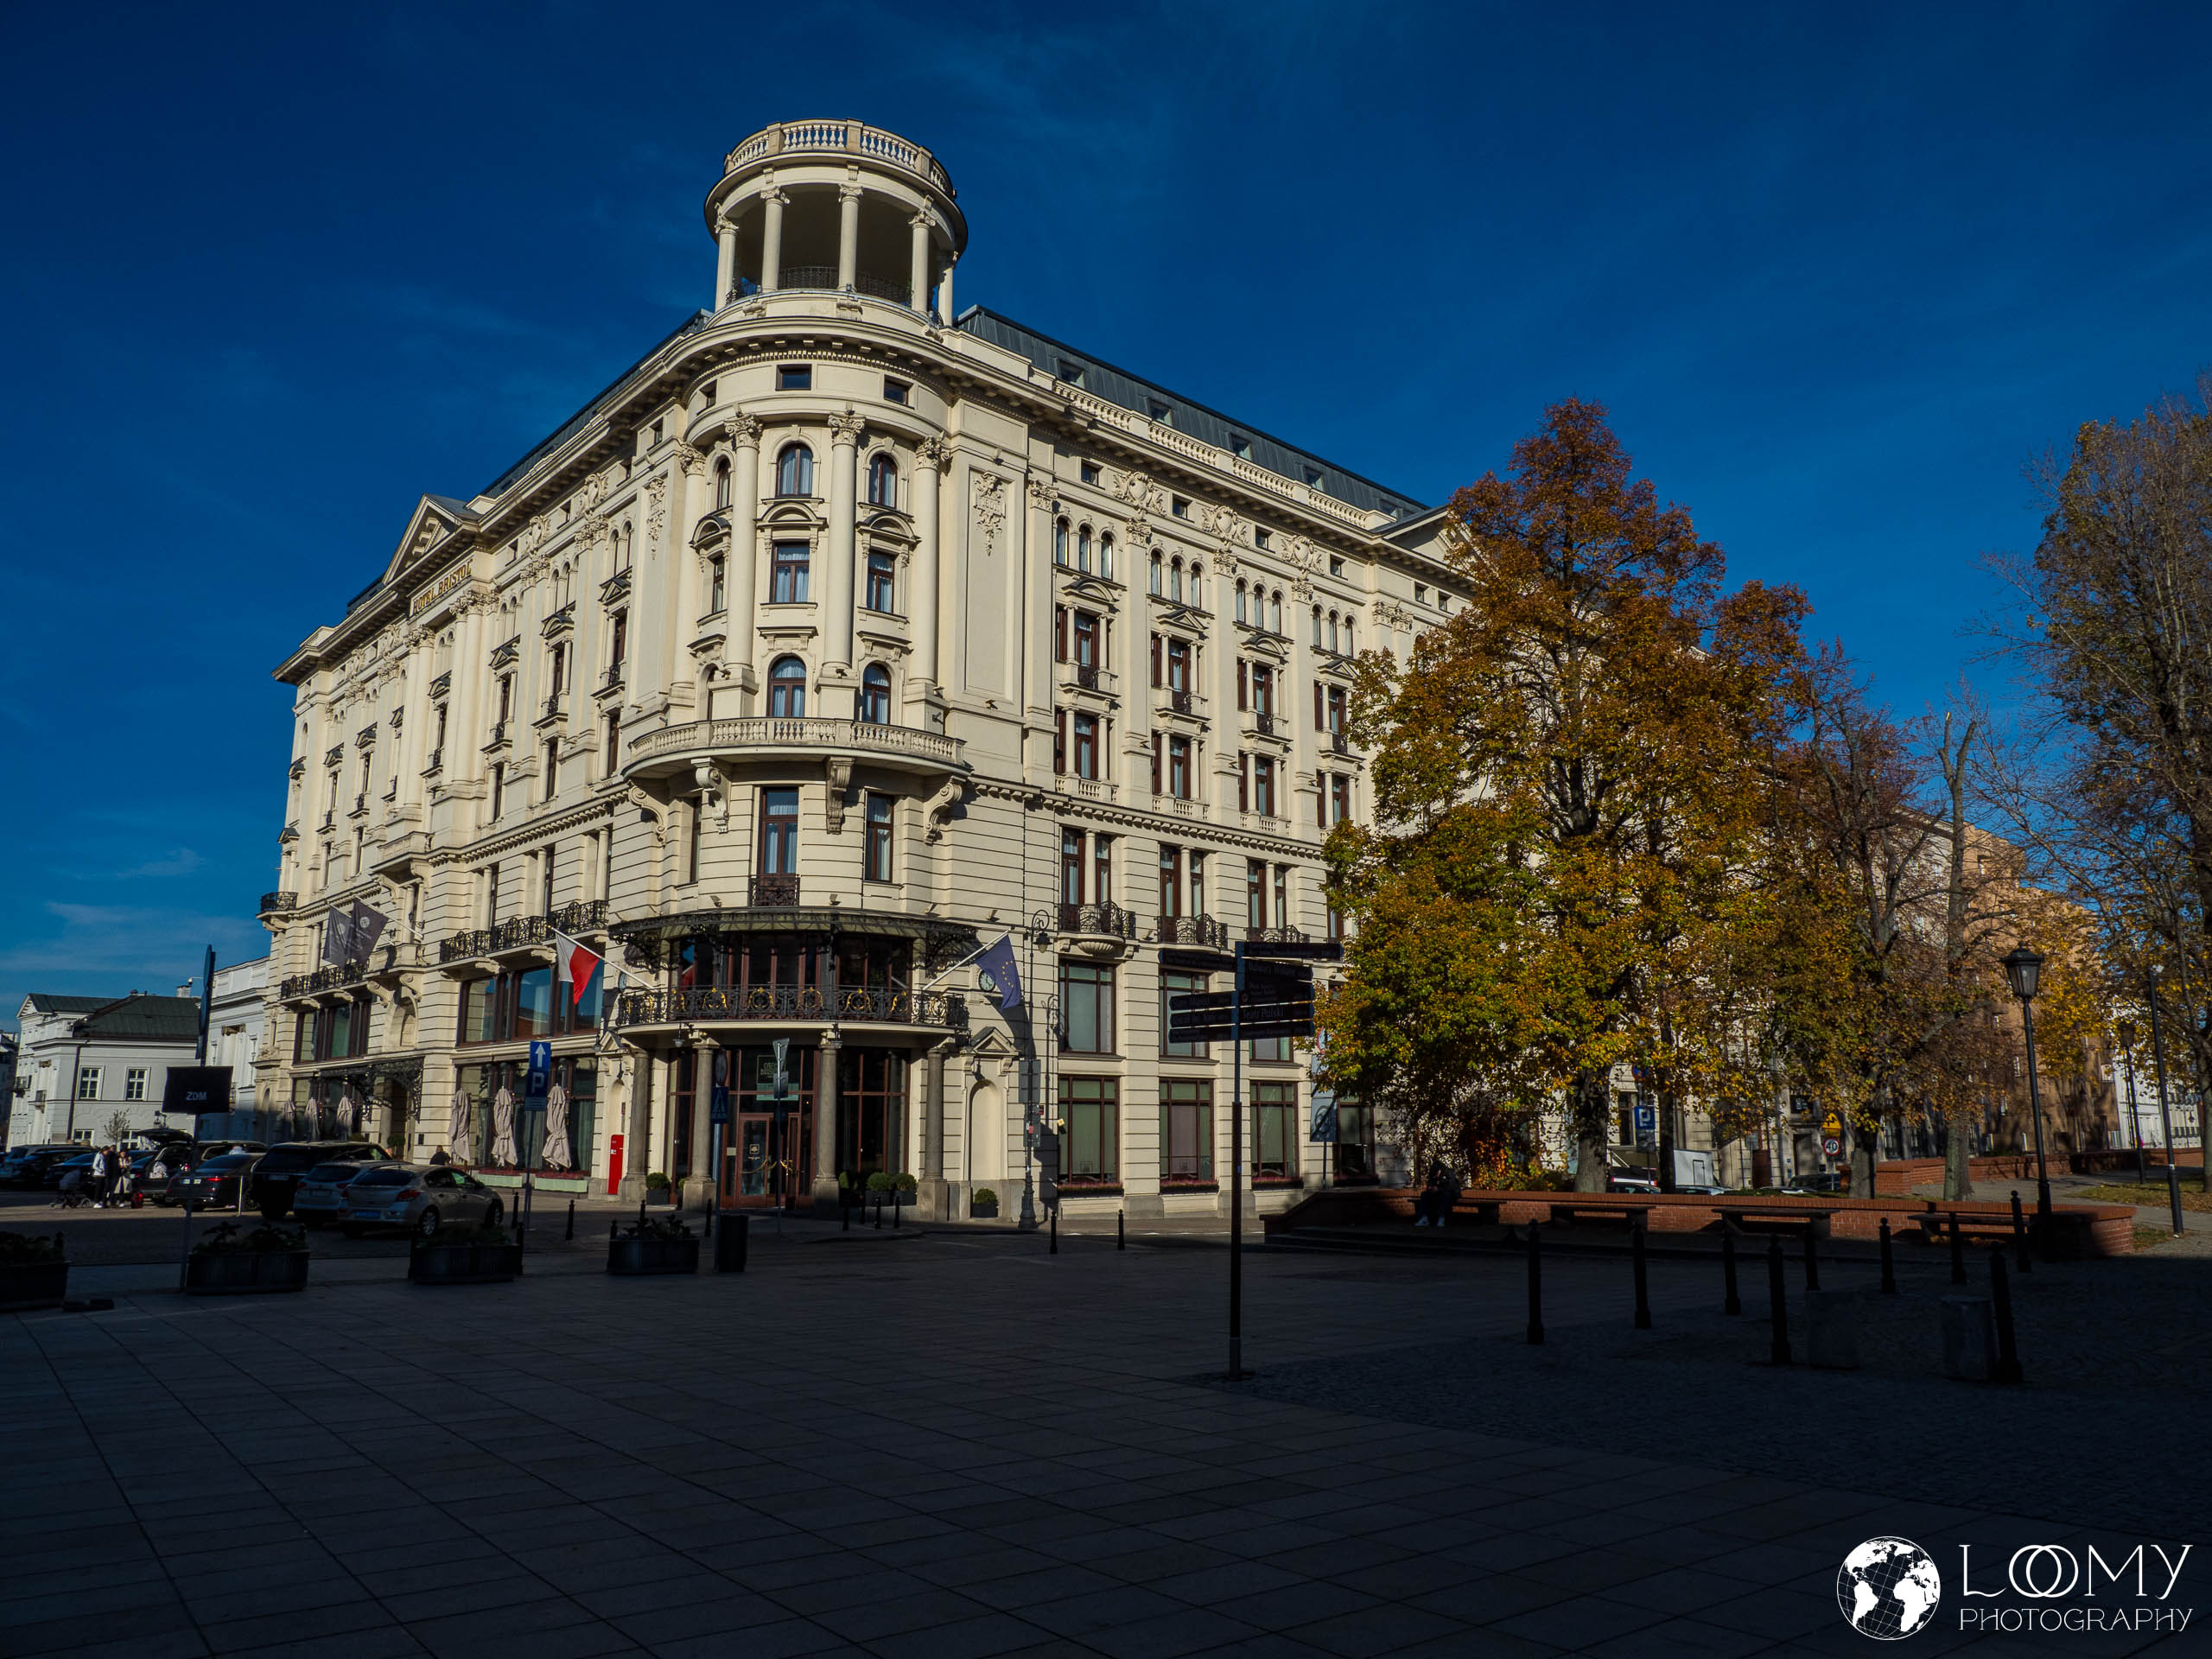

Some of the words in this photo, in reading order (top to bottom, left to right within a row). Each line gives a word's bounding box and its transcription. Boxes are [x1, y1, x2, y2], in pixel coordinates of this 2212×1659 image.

[413, 588, 436, 613] HOTEL
[438, 558, 473, 595] BRISTOL
[531, 1071, 545, 1093] P
[186, 1091, 208, 1102] ZDM
[1637, 1108, 1651, 1127] P
[1826, 1141, 1838, 1151] 40
